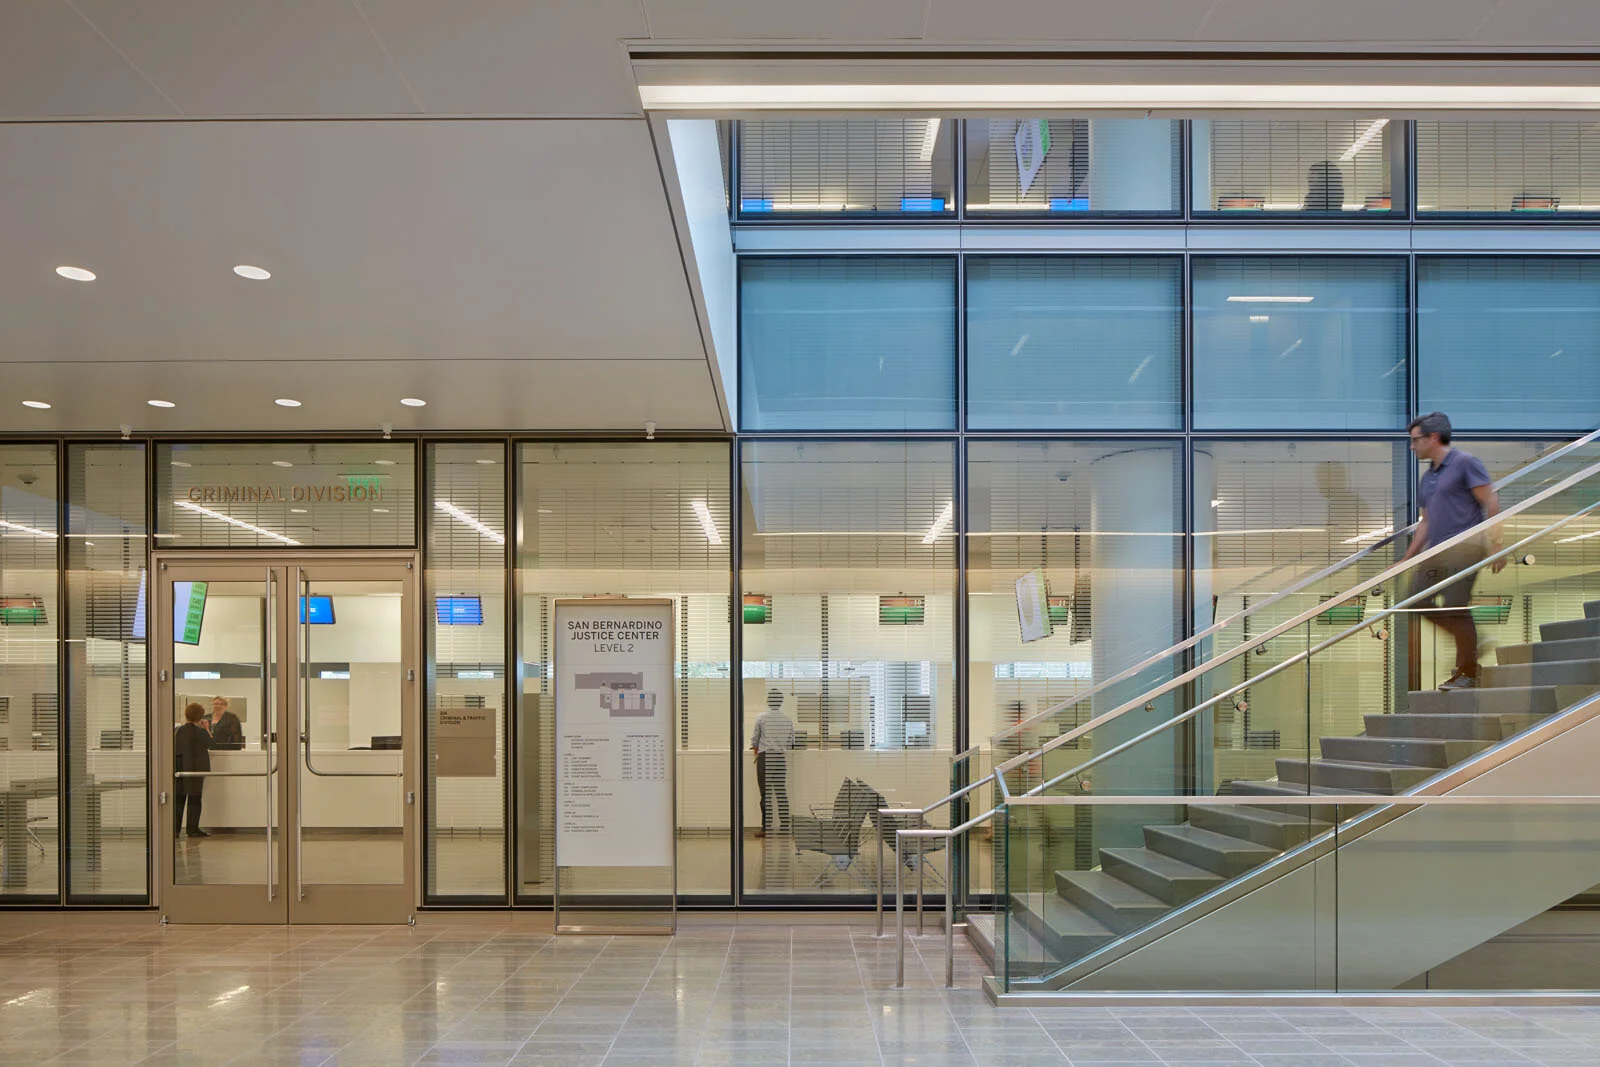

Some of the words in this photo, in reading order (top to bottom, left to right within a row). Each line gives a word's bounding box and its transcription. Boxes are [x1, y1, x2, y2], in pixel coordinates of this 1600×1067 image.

[187, 485, 286, 501] CRIMINAL
[291, 485, 383, 501] DIVISION
[567, 620, 590, 630] SAN
[592, 620, 663, 630] BERNARDINO
[571, 631, 615, 641] JUSTICE
[617, 631, 660, 641] CENTER
[594, 644, 625, 653] LEVEL
[627, 644, 634, 653] 2
